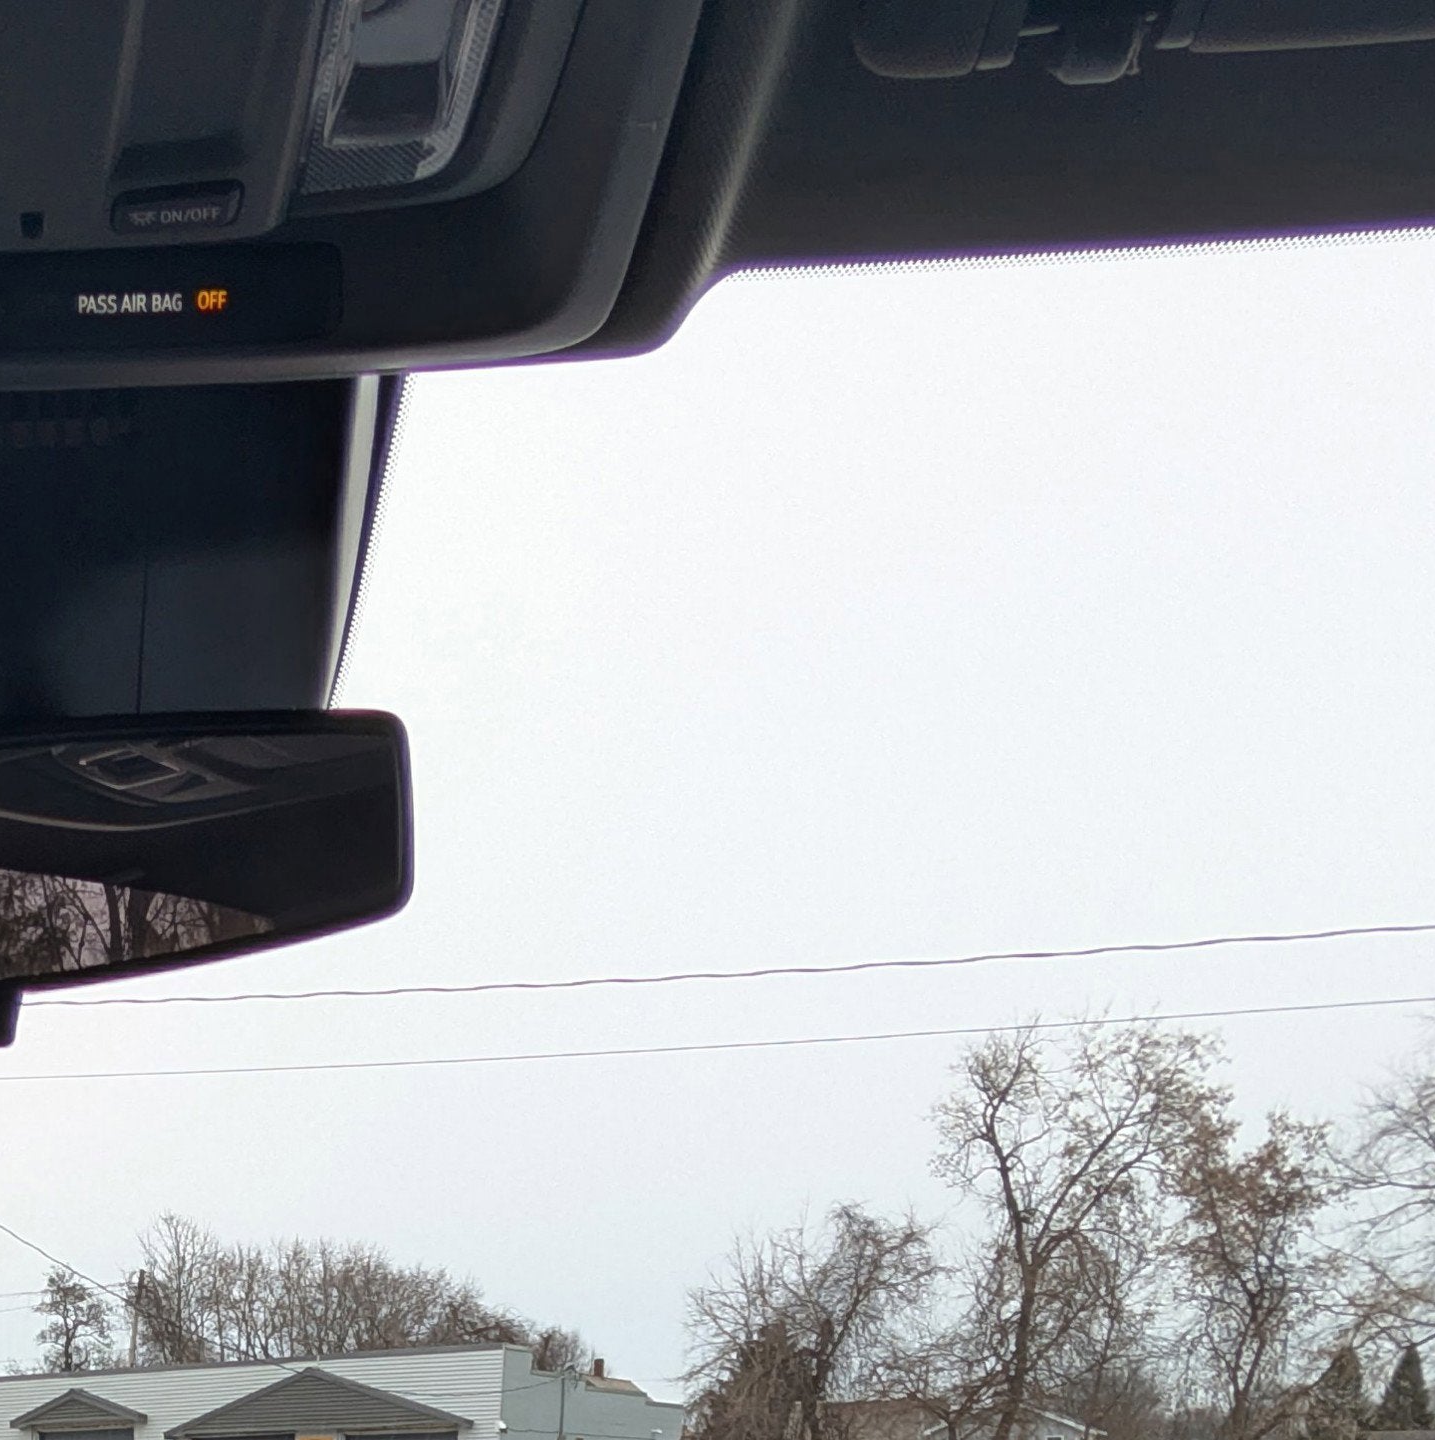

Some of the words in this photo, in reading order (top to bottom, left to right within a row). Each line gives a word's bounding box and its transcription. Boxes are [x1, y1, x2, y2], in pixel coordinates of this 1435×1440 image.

[160, 206, 221, 224] ON/OFF
[78, 294, 117, 314] PASS
[120, 293, 147, 313] AIR
[151, 293, 183, 313] BAG
[197, 289, 227, 311] OFF
